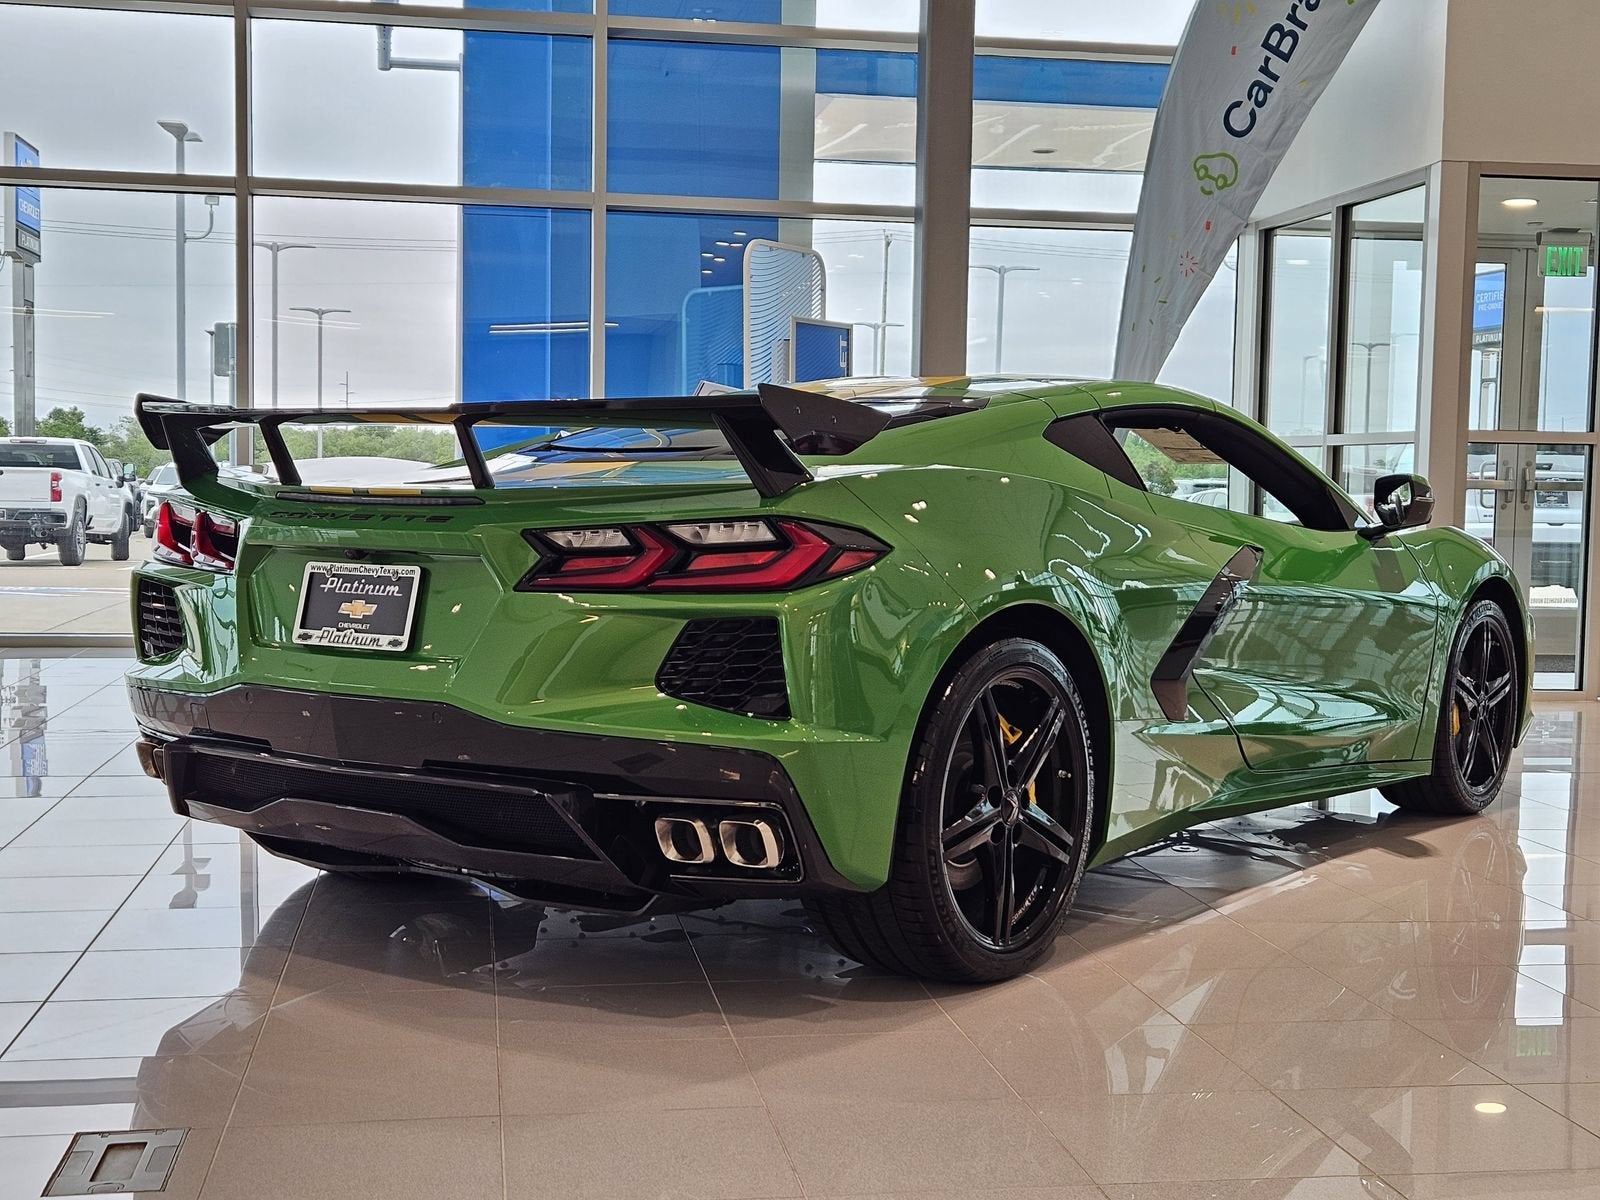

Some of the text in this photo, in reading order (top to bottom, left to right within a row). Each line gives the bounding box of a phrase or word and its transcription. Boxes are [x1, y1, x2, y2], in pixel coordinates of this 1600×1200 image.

[1546, 246, 1584, 276] EXIT
[1475, 290, 1504, 303] CERTIFIE
[268, 511, 454, 523] CORVETTE
[319, 577, 403, 597] Platinum
[338, 621, 371, 629] CHEVROLET
[315, 629, 383, 647] Platinum
